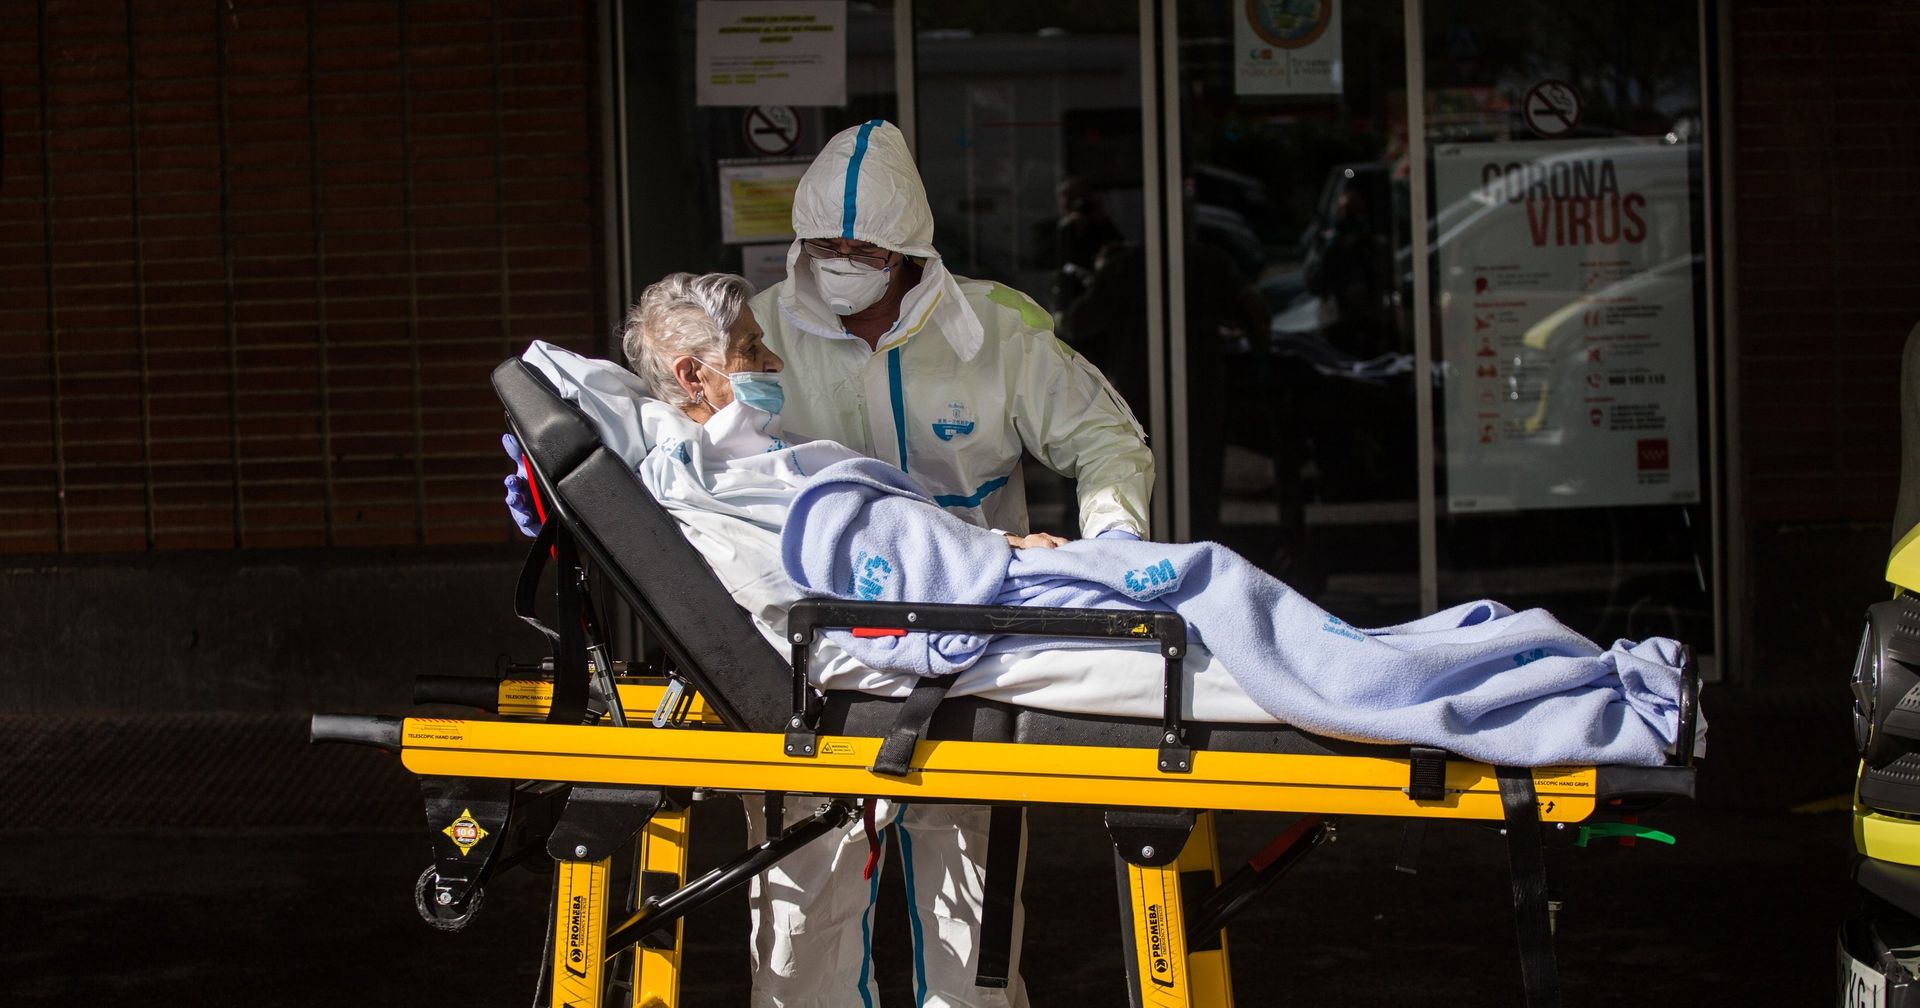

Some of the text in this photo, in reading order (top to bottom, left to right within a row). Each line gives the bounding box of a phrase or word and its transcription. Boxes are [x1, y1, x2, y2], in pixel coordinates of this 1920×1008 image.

[1481, 159, 1620, 204] CORONA
[1526, 192, 1647, 247] VIRUS
[455, 828, 466, 836] 10
[570, 895, 581, 948] PROMEBA
[1148, 904, 1160, 958] PROMEBA
